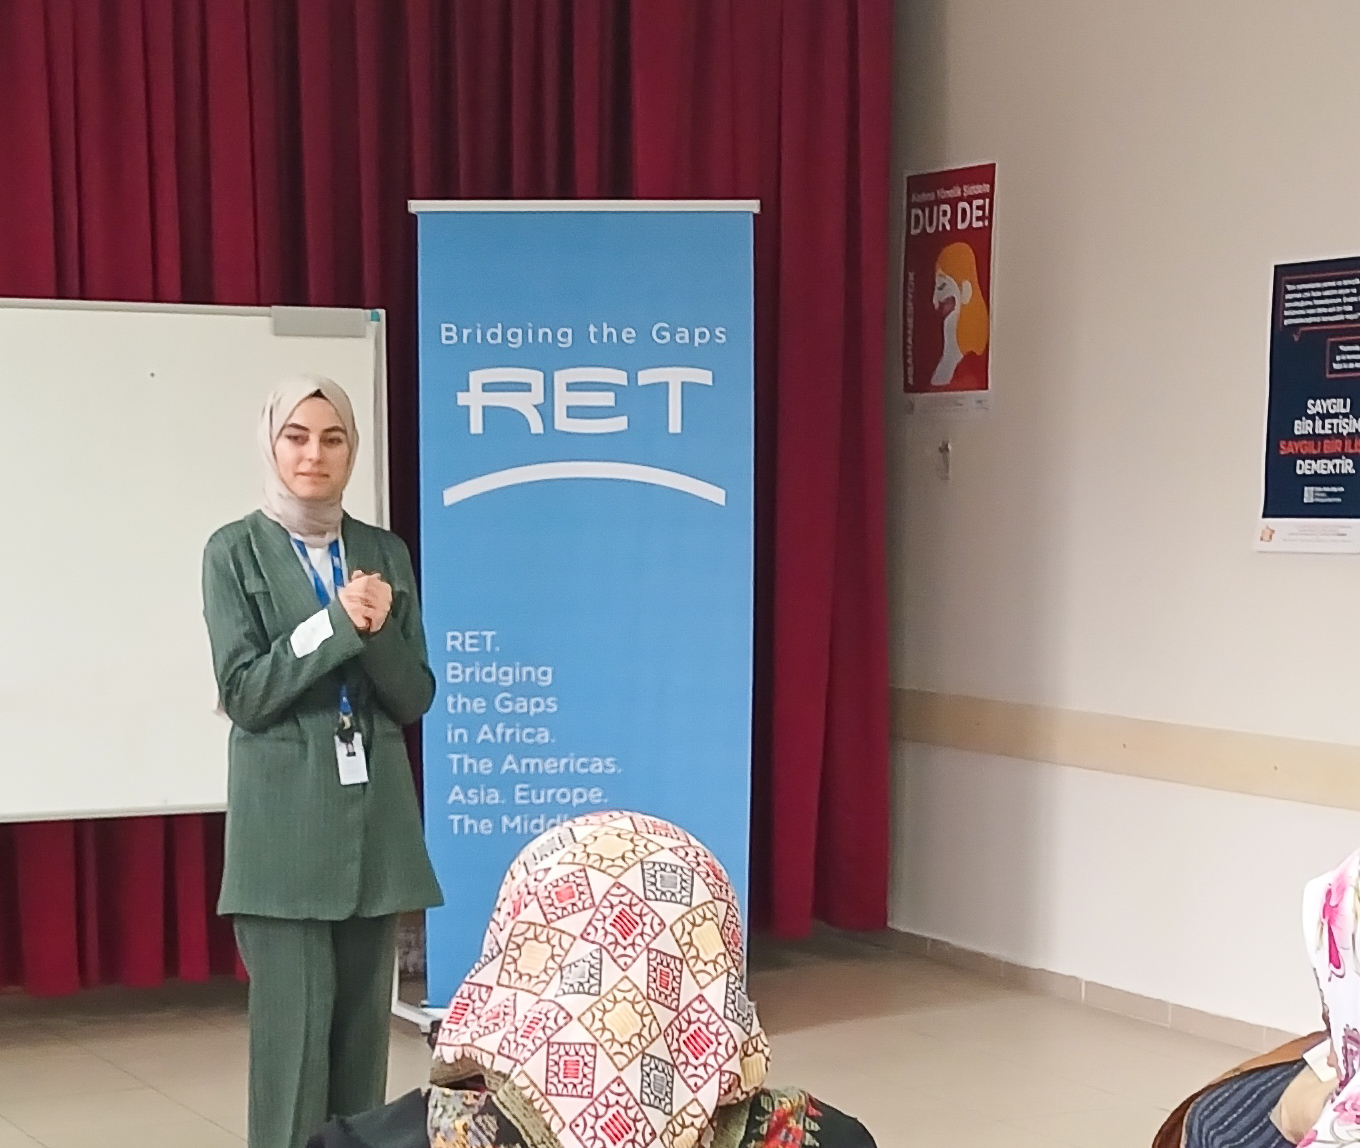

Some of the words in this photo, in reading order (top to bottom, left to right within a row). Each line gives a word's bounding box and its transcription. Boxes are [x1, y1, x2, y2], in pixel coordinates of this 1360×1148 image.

[910, 203, 951, 236] DUR
[957, 197, 990, 230] DE!
[440, 322, 573, 348] Bridging
[588, 322, 637, 344] the
[651, 322, 728, 347] Gaps
[456, 366, 714, 435] RET
[1306, 397, 1351, 415] SAYGILI
[445, 631, 501, 652] RET.
[446, 662, 554, 687] Bridging
[446, 693, 487, 714] the
[494, 692, 559, 717] Gaps
[446, 723, 468, 744] in
[476, 723, 556, 744] Africa.
[446, 753, 493, 775] The
[500, 753, 622, 775] Americas.
[447, 785, 505, 805] Asia.
[514, 783, 608, 808] Europe.
[447, 814, 493, 835] The
